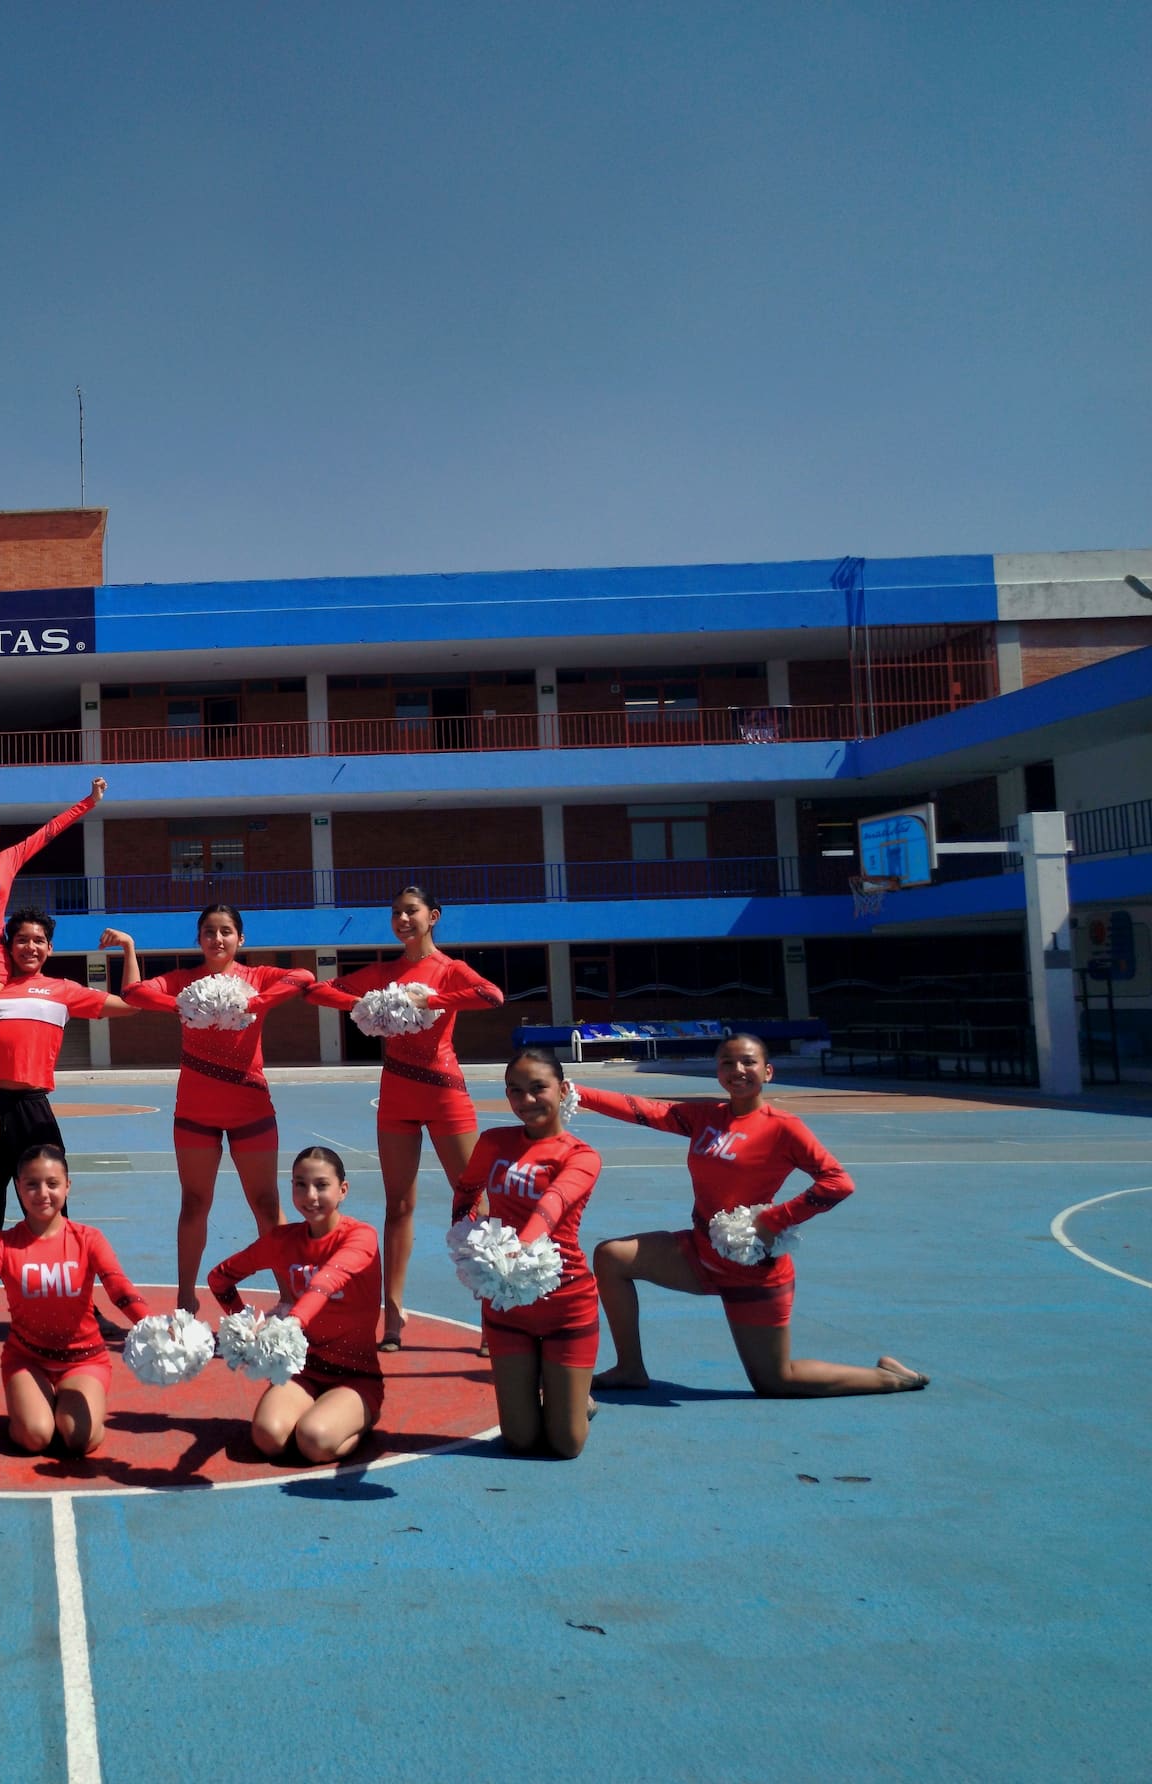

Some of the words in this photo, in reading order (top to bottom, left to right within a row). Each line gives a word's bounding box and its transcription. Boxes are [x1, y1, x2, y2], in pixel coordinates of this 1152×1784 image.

[28, 987, 52, 995] CMC
[693, 1125, 747, 1160] CMC
[488, 1158, 551, 1199] CMC
[21, 1260, 82, 1298] CMC
